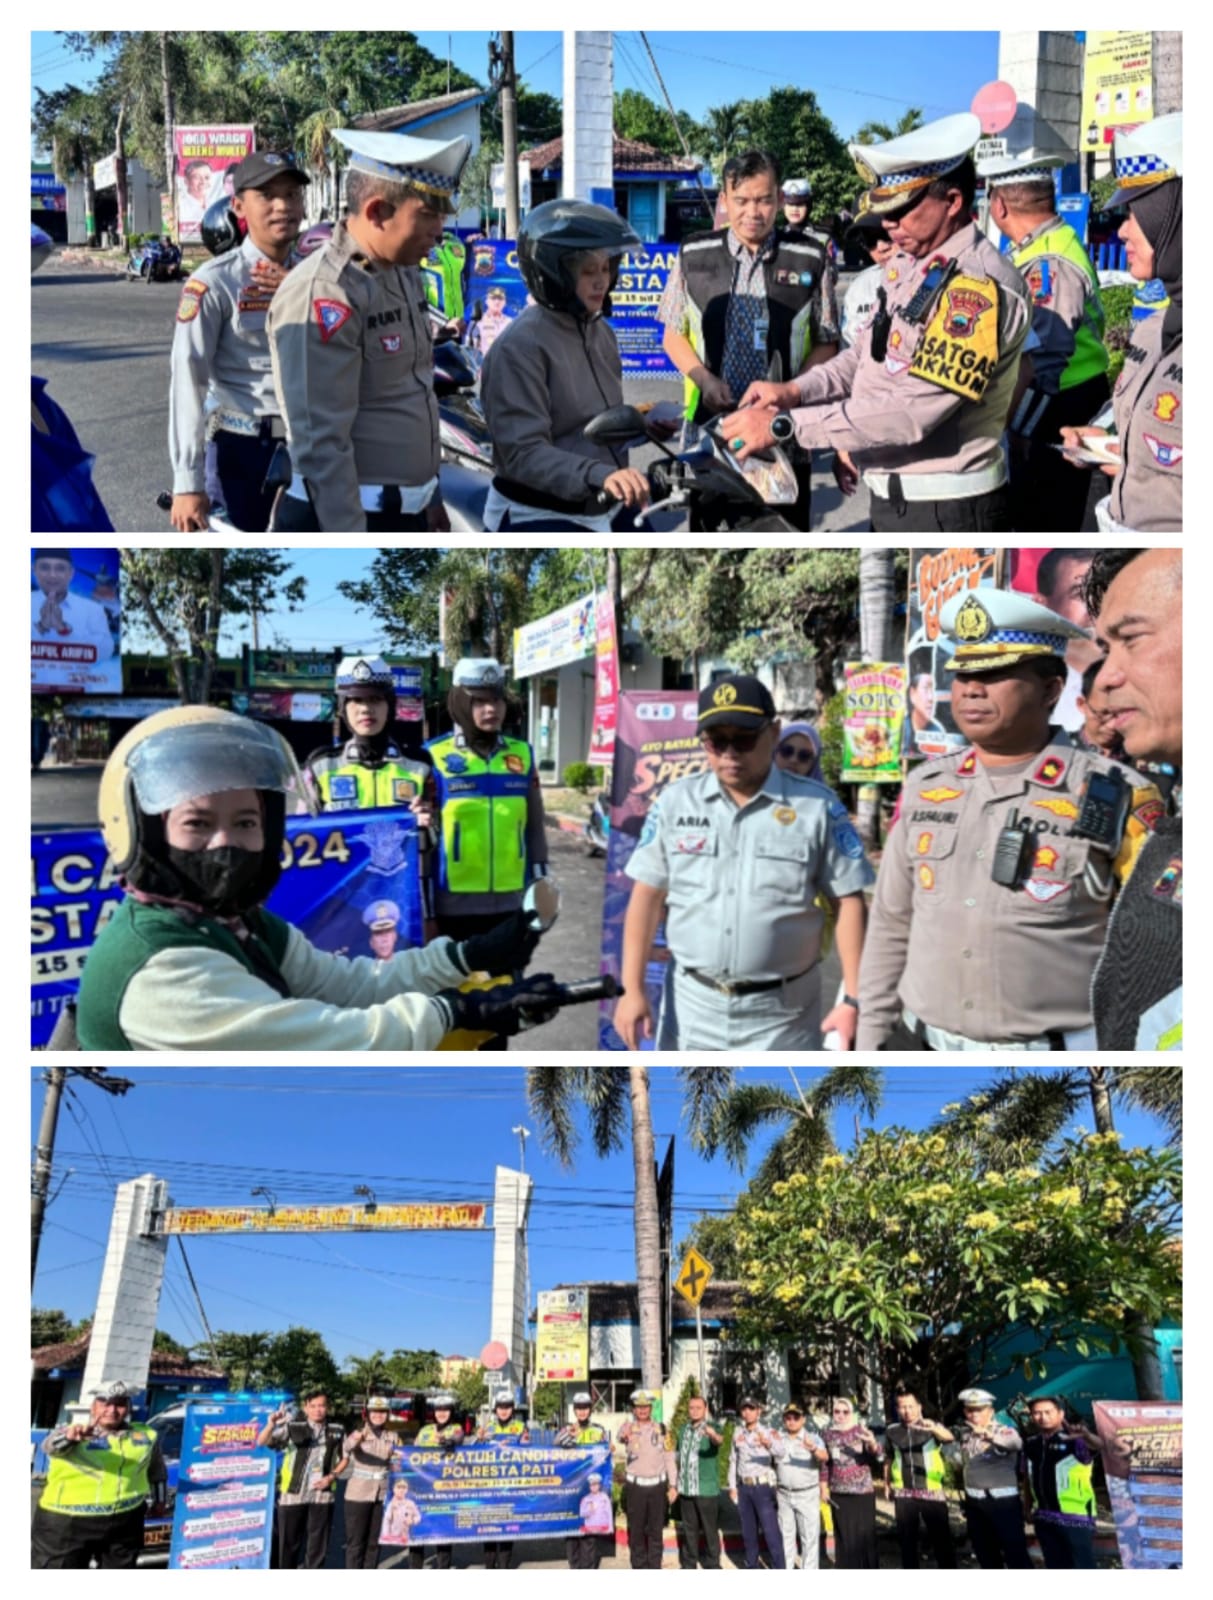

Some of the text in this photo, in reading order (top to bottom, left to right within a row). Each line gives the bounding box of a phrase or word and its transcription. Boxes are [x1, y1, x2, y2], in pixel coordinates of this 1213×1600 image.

[846, 691, 904, 709] SOTO
[676, 816, 711, 828] ARIA
[37, 955, 68, 975] 15
[1113, 1435, 1182, 1457] SPECIA
[409, 1452, 441, 1466] OPS
[444, 1450, 496, 1464] PATUH
[499, 1448, 550, 1463] CANDI
[442, 1463, 555, 1479] POLRESTA PATI
